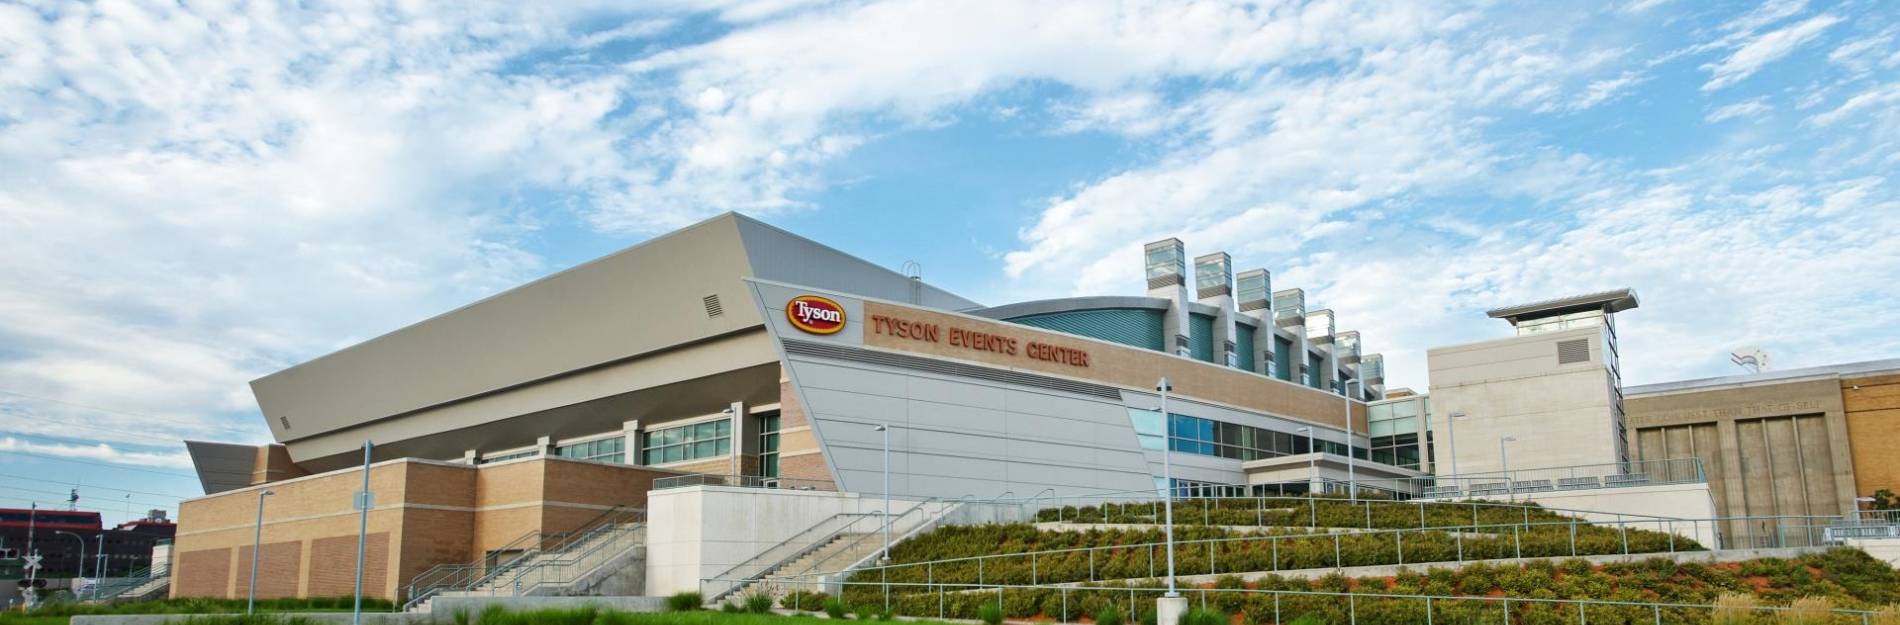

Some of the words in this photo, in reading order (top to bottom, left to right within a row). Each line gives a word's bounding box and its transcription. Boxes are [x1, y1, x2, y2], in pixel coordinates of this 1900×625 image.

[795, 300, 841, 323] Tyson
[872, 314, 939, 343] TYSON
[949, 327, 1018, 356] EVENTS
[1026, 342, 1089, 367] CENTER
